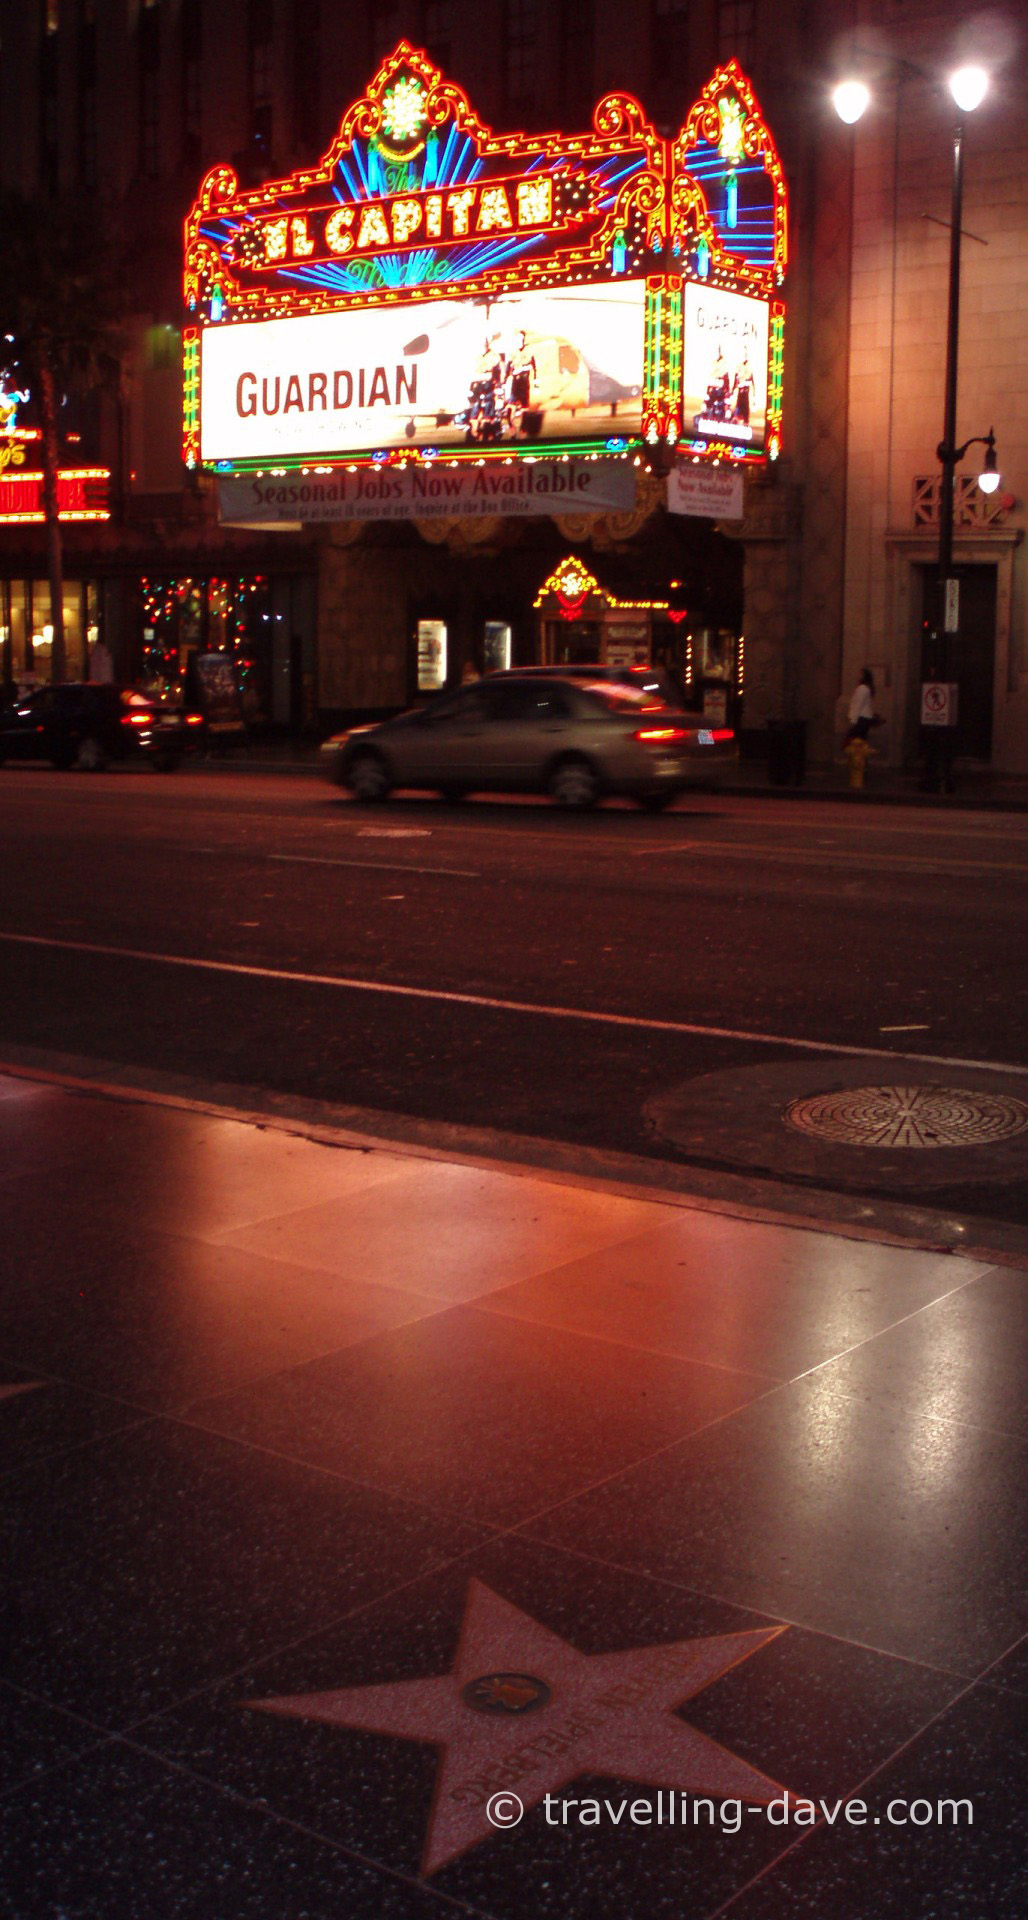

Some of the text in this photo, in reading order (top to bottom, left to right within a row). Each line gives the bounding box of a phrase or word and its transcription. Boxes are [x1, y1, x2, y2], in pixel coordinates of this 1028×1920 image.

[252, 464, 592, 504] Seasonal Jobs Now Available
